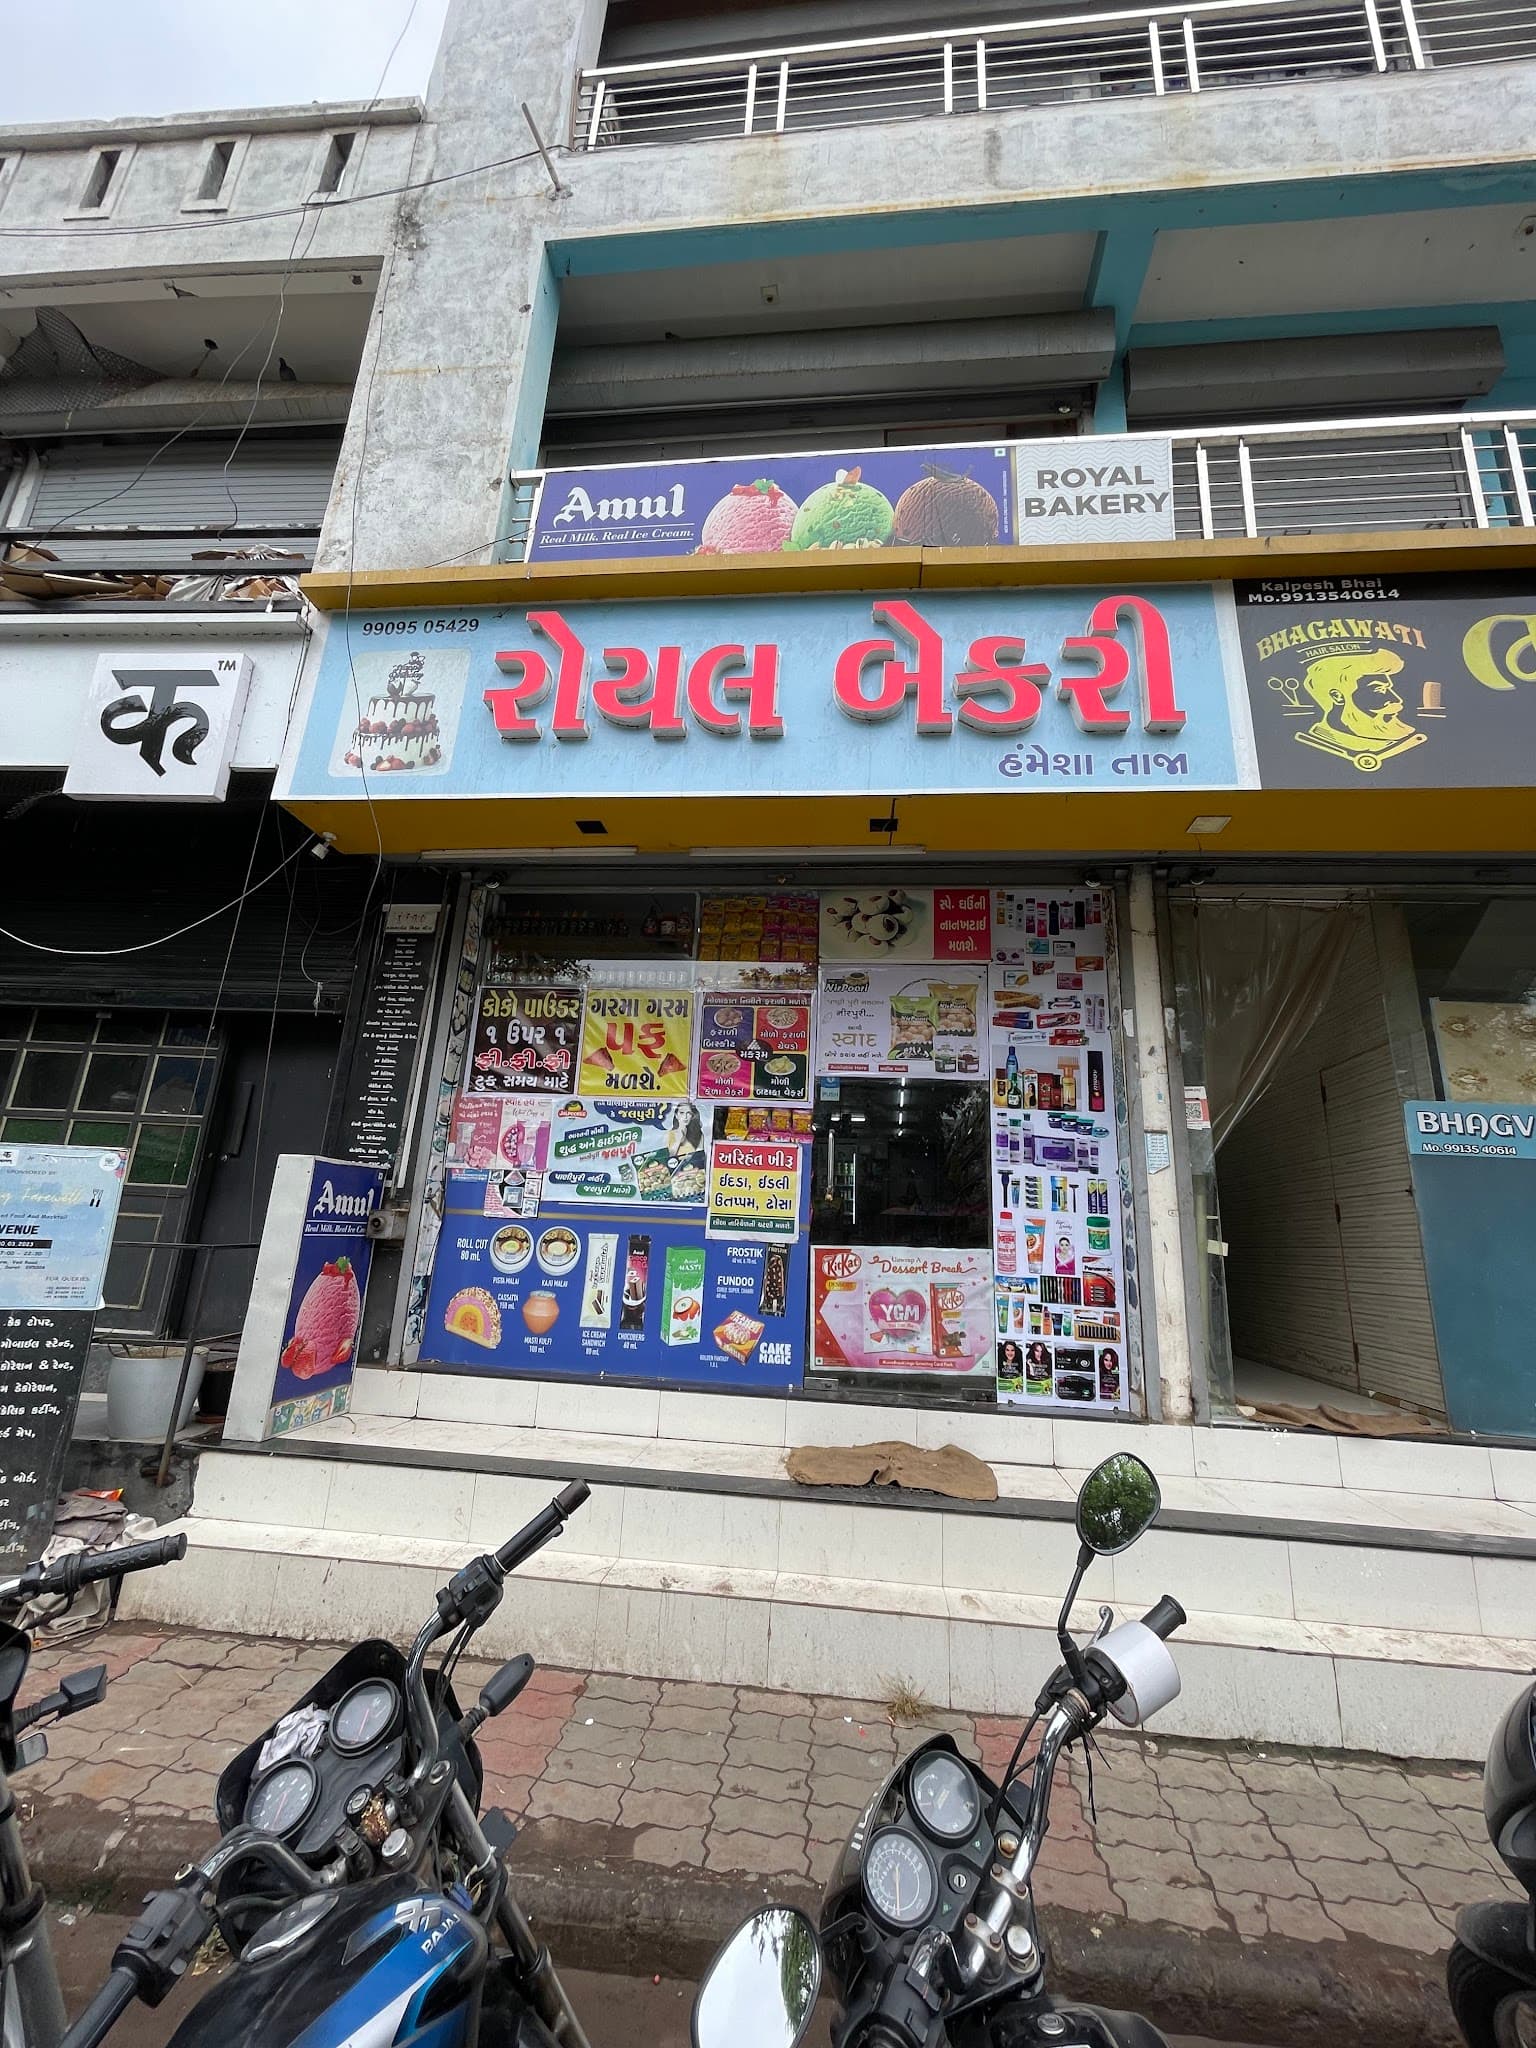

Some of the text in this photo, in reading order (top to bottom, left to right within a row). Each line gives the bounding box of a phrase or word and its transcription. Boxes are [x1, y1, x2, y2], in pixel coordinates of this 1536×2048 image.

[1037, 466, 1154, 489] ROYAL
[553, 483, 686, 528] Amul
[1024, 492, 1169, 517] BAKERY
[540, 527, 694, 544] Real Milk. Real Ice Cream.
[1261, 578, 1382, 592] Kalpesh Bhai
[1248, 589, 1400, 604] Mo.9913540614
[362, 617, 480, 636] 99095 05429
[1256, 618, 1426, 661] BHAGAWATI
[1305, 643, 1360, 658] HAIR SALON
[483, 594, 1188, 740] રોયલ બેકરી
[998, 743, 1190, 778] હંમેશા તાજા
[482, 990, 580, 1018] કોકો પાઉડર
[591, 998, 689, 1018] ગરમા ગરમ
[506, 1018, 545, 1045] ઉપર
[605, 1022, 667, 1060] પફ
[503, 1074, 538, 1088] સમય
[543, 1073, 570, 1089] માટે
[605, 1067, 661, 1090] મળશે.
[1416, 1111, 1534, 1139] BHAGV
[719, 1148, 763, 1166] અરિહંત
[1422, 1144, 1517, 1155] Mo. 99135 40614
[758, 1175, 790, 1190] ઈડલી
[313, 1180, 375, 1218] Amul
[766, 1194, 791, 1210] ઢોસા
[457, 1238, 488, 1249] ROLL CUT
[727, 1247, 763, 1258] FROSTIK
[826, 1253, 861, 1278] KitKat
[881, 1259, 965, 1275] Dessert Break
[717, 1276, 754, 1287] FUNDOO
[880, 1303, 919, 1322] YGM
[760, 1342, 792, 1355] CAKE
[38, 1360, 49, 1370] &
[759, 1354, 792, 1366] MAGIC
[421, 1913, 461, 1956] BAJAJ
